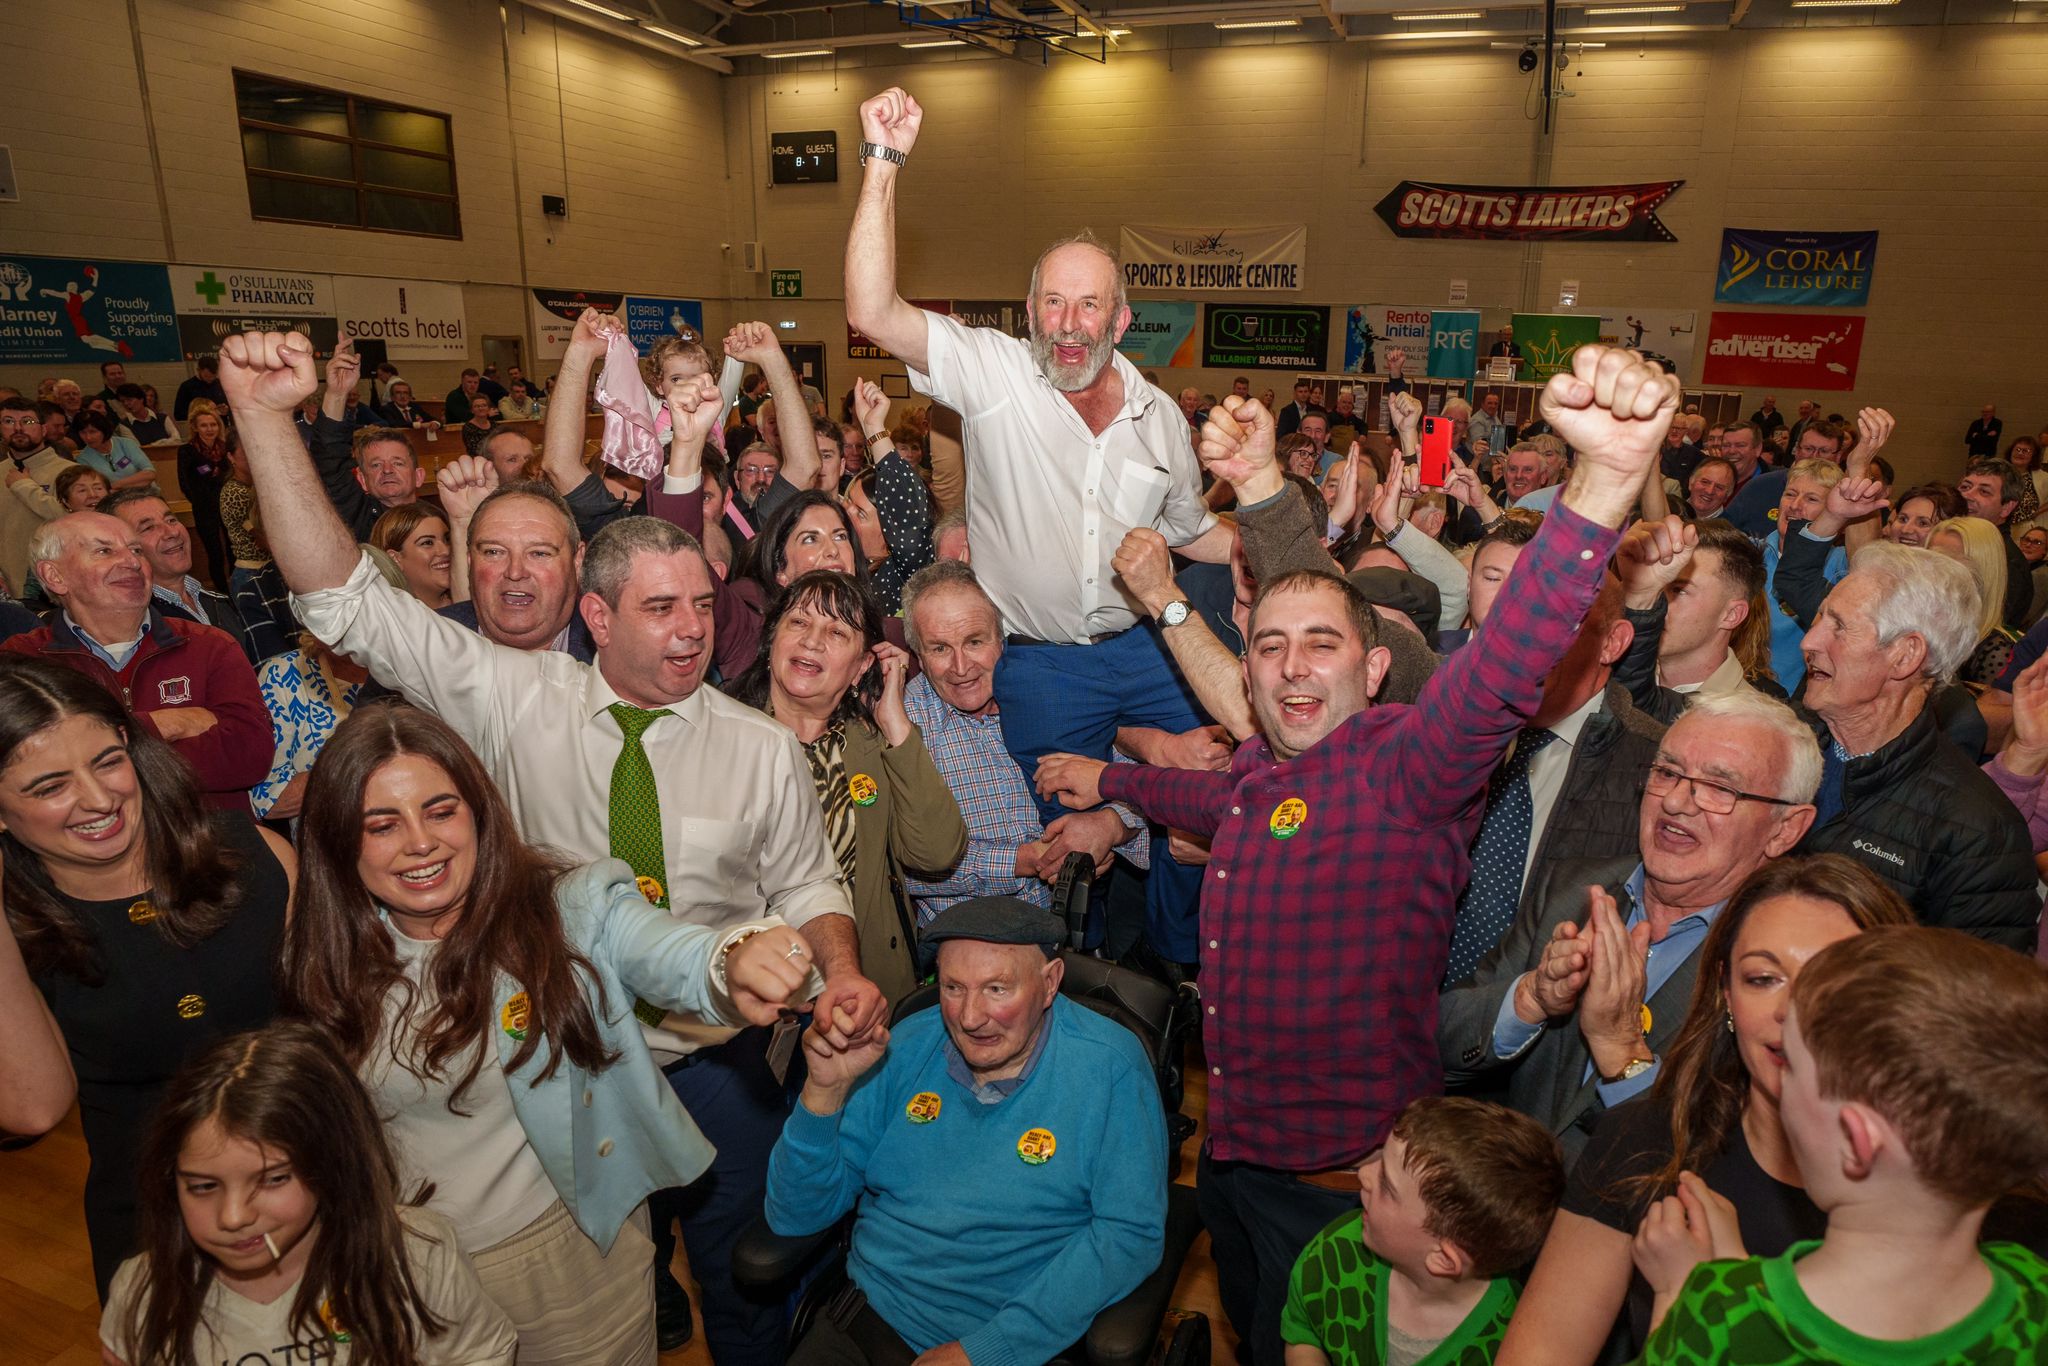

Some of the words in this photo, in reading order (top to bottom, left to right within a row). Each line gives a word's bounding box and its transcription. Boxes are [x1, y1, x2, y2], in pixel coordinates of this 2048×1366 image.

[772, 146, 794, 155] HOME
[805, 144, 835, 154] GUESTS
[813, 156, 819, 166] 7
[1400, 193, 1516, 226] SCOTTS
[1517, 194, 1636, 228] LAKERS
[1765, 249, 1866, 271] CORAL
[772, 272, 786, 280] Fire
[787, 272, 800, 280] exit
[1124, 263, 1172, 287] SPORTS
[1176, 264, 1186, 287] &
[1190, 264, 1243, 288] LEISURE
[1246, 264, 1298, 288] CENTRE
[1765, 274, 1864, 290] LEISURE
[229, 275, 314, 291] O'SULLIVANS
[104, 297, 150, 311] Proudly
[231, 290, 316, 305] PHARMACY
[630, 304, 664, 317] O'BRIEN
[1386, 310, 1430, 324] Rento
[107, 311, 173, 326] Supporting
[964, 313, 997, 326] RIAN
[24, 327, 63, 337] Union
[110, 325, 126, 337] St.
[128, 325, 158, 337] Pauls
[346, 317, 410, 338] scotts
[416, 317, 462, 339] hotel
[630, 320, 664, 332] COFFEY
[1126, 323, 1171, 333] OLEUM
[1386, 324, 1425, 338] Initial
[850, 346, 868, 357] GET
[869, 346, 878, 357] IT
[1256, 344, 1304, 352] SUPPORTING
[1710, 334, 1822, 359] advertiser
[1210, 354, 1257, 364] KILLARNEY
[1258, 356, 1316, 366] BASKETBALL
[1862, 842, 1905, 866] Columbia
